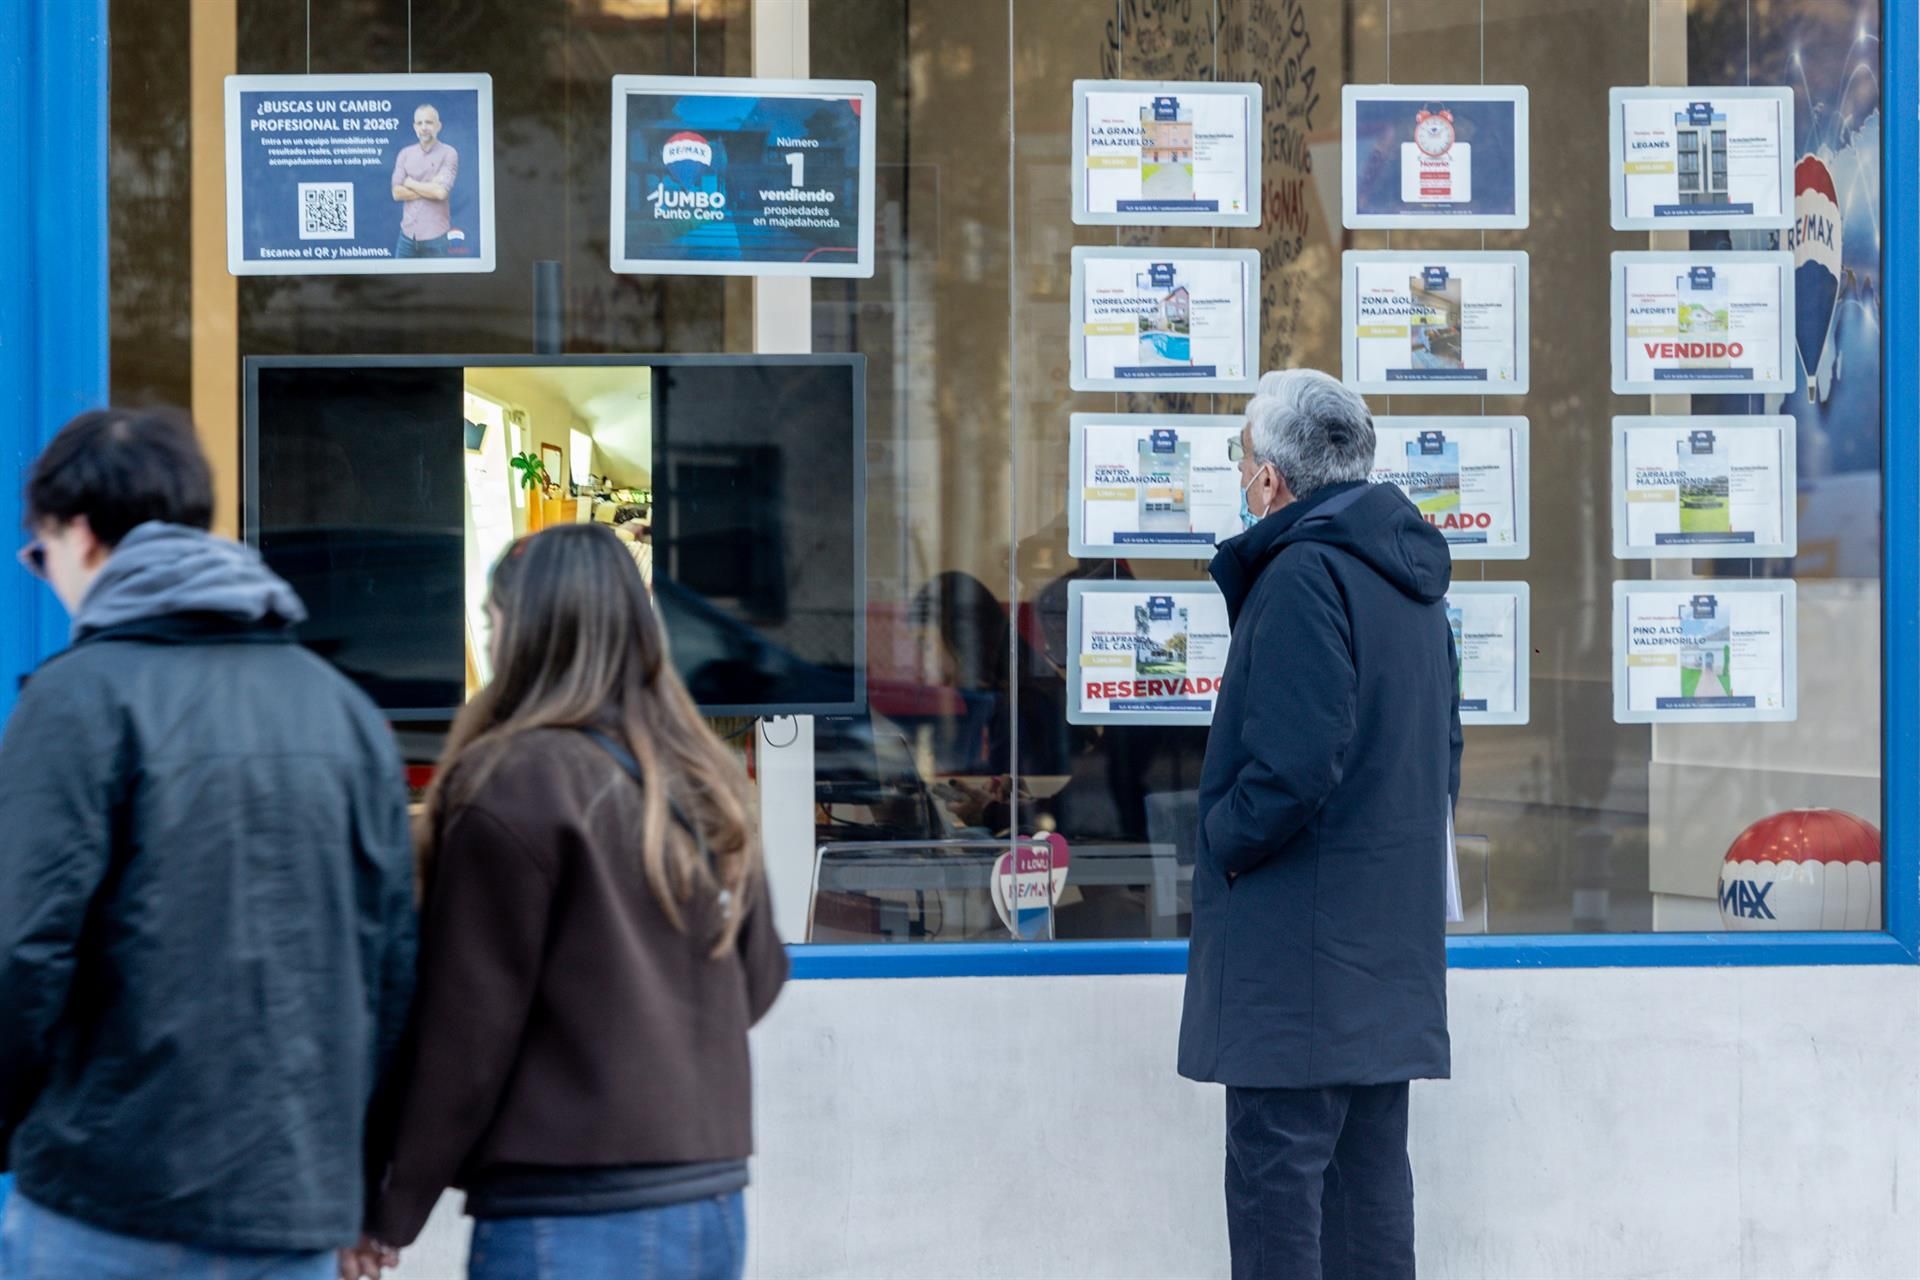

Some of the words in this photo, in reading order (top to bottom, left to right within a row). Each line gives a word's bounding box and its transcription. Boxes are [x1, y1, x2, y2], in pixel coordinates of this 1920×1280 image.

[257, 100, 313, 115] ¿BUSCAS
[316, 100, 337, 113] UN
[340, 100, 392, 113] CAMBIO
[251, 118, 339, 132] PROFESIONAL
[343, 118, 360, 130] EN
[363, 118, 399, 131] 2026?
[1091, 127, 1105, 135] LA
[1107, 126, 1147, 135] GRANJA
[261, 137, 281, 146] Entra
[304, 138, 329, 147] equipo
[331, 137, 374, 145] inmobiliario
[777, 137, 819, 148] Número
[1091, 137, 1155, 146] PALAZUELOS
[1632, 141, 1670, 149] LEGANÉS
[669, 145, 707, 158] RE/MAX
[269, 158, 332, 167] acompañamiento
[785, 152, 805, 187] 1
[647, 182, 726, 208] JUMBO
[758, 188, 835, 202] vendiendo
[654, 208, 691, 220] Punto
[695, 208, 724, 220] Cero
[764, 205, 829, 217] propiedades
[753, 218, 767, 226] en
[769, 217, 840, 229] majadahonda
[1787, 213, 1834, 251] RE/MAX
[260, 247, 300, 257] Escanea
[303, 247, 312, 257] el
[315, 247, 329, 258] QR
[331, 249, 337, 259] y
[340, 246, 392, 257] hablamos.
[1361, 297, 1389, 305] ZONA
[1361, 307, 1437, 315] MAJADAHONDA
[1644, 342, 1744, 359] VENDIDO
[1095, 468, 1130, 476] CENTRO
[1095, 476, 1171, 484] MAJADAHONDA
[1633, 626, 1656, 635] PINO
[1659, 626, 1683, 635] ALTO
[1633, 638, 1706, 646] VALDEMORILLO
